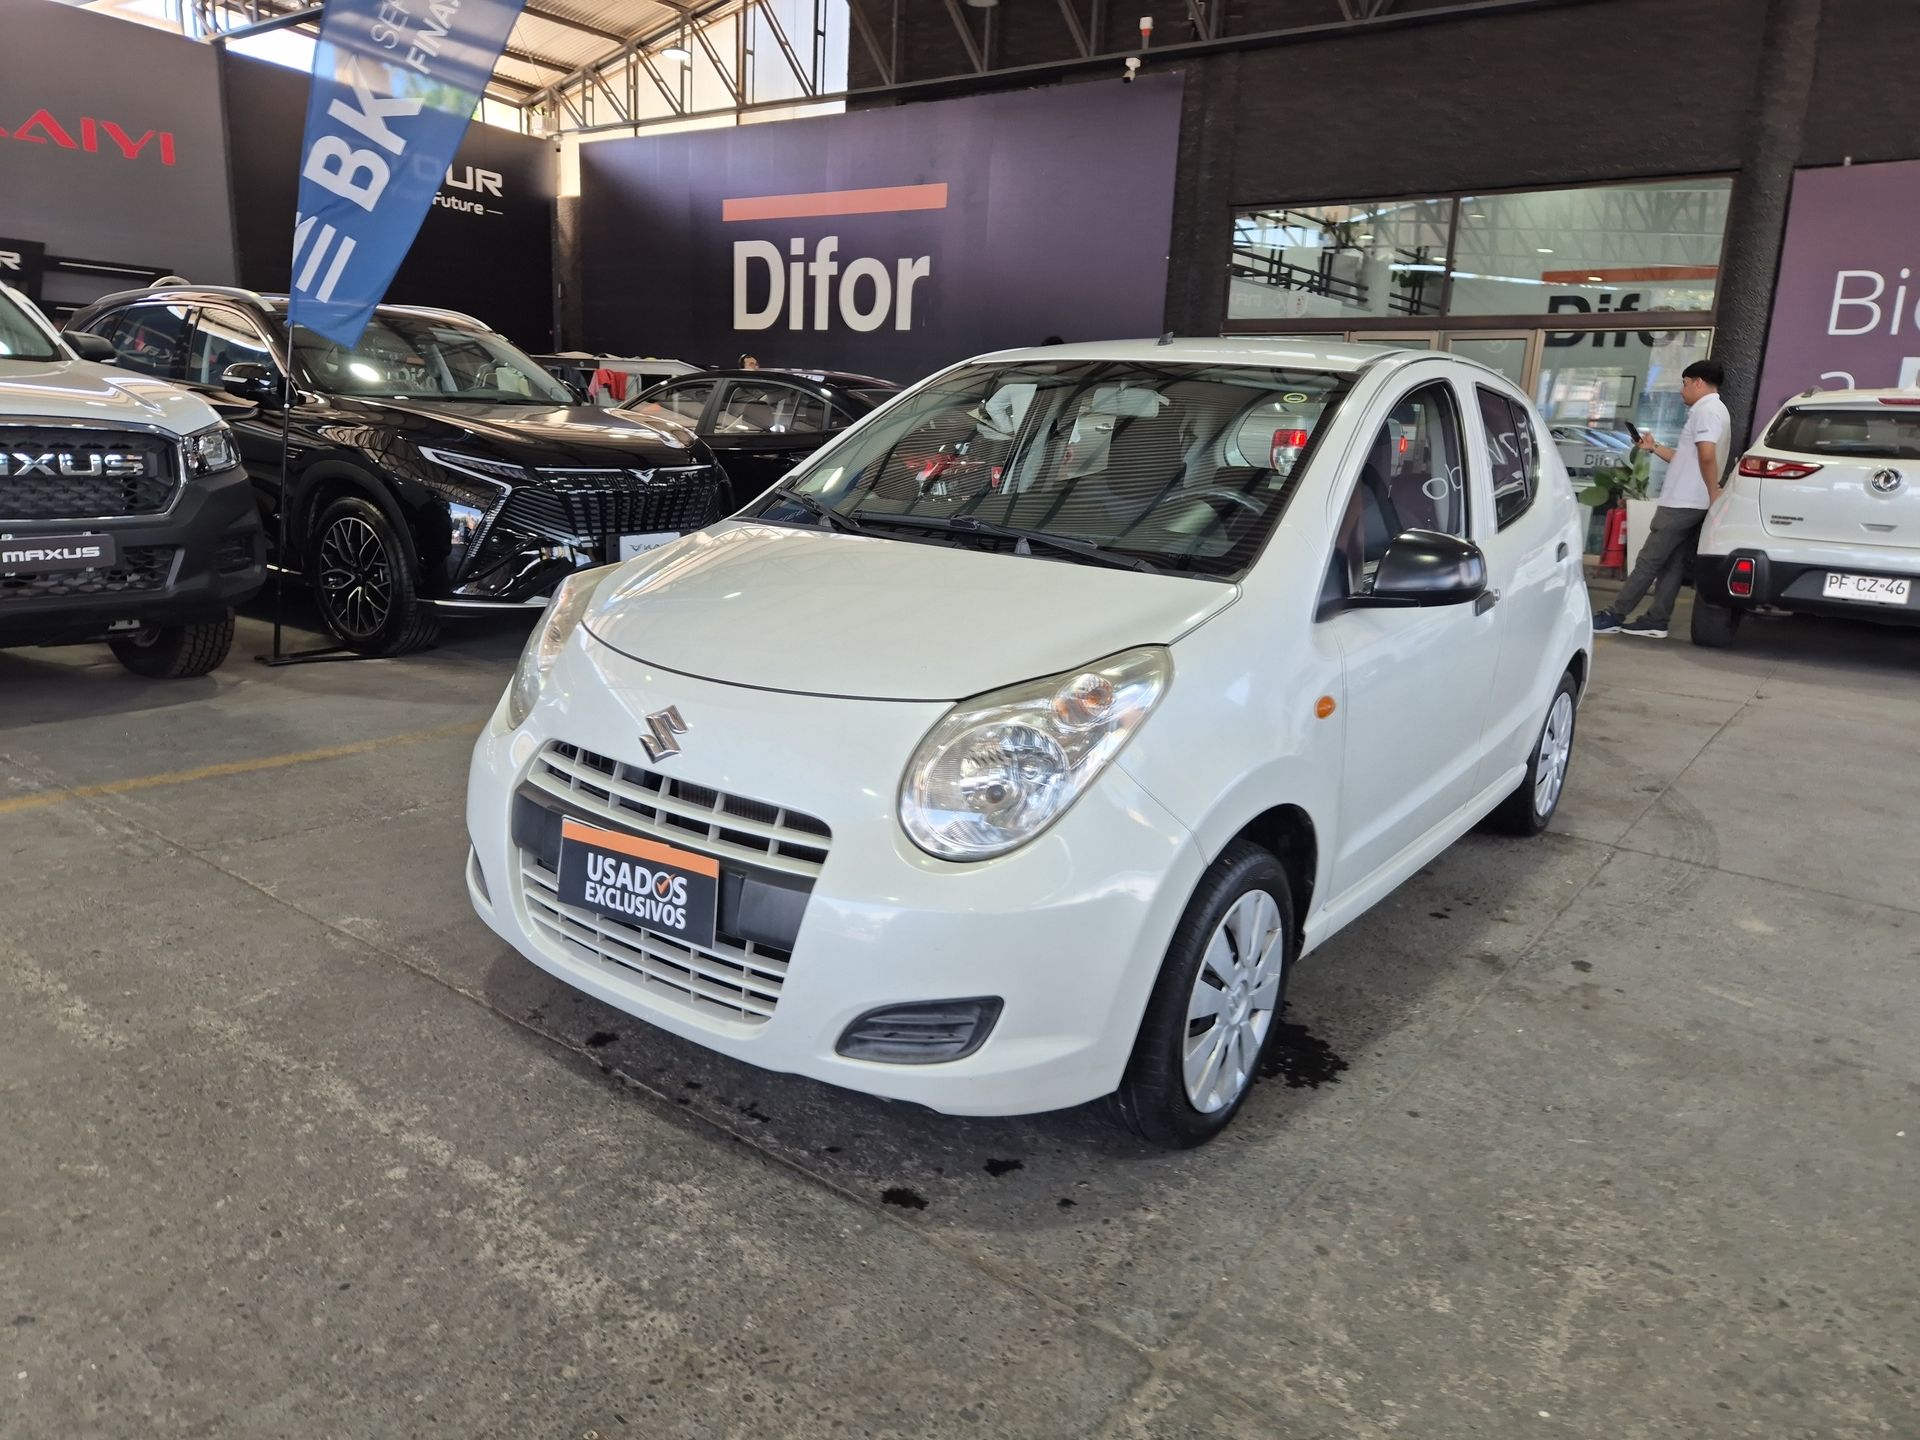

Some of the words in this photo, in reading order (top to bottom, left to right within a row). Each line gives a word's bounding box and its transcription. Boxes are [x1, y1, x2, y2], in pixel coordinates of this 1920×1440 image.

[0, 108, 177, 166] AIYI
[733, 235, 931, 332] Difor
[1827, 267, 1920, 336] Bi
[2, 546, 100, 563] MAXUS
[584, 881, 687, 930] EXCLUSIVOS
[587, 852, 688, 907] USADOS
